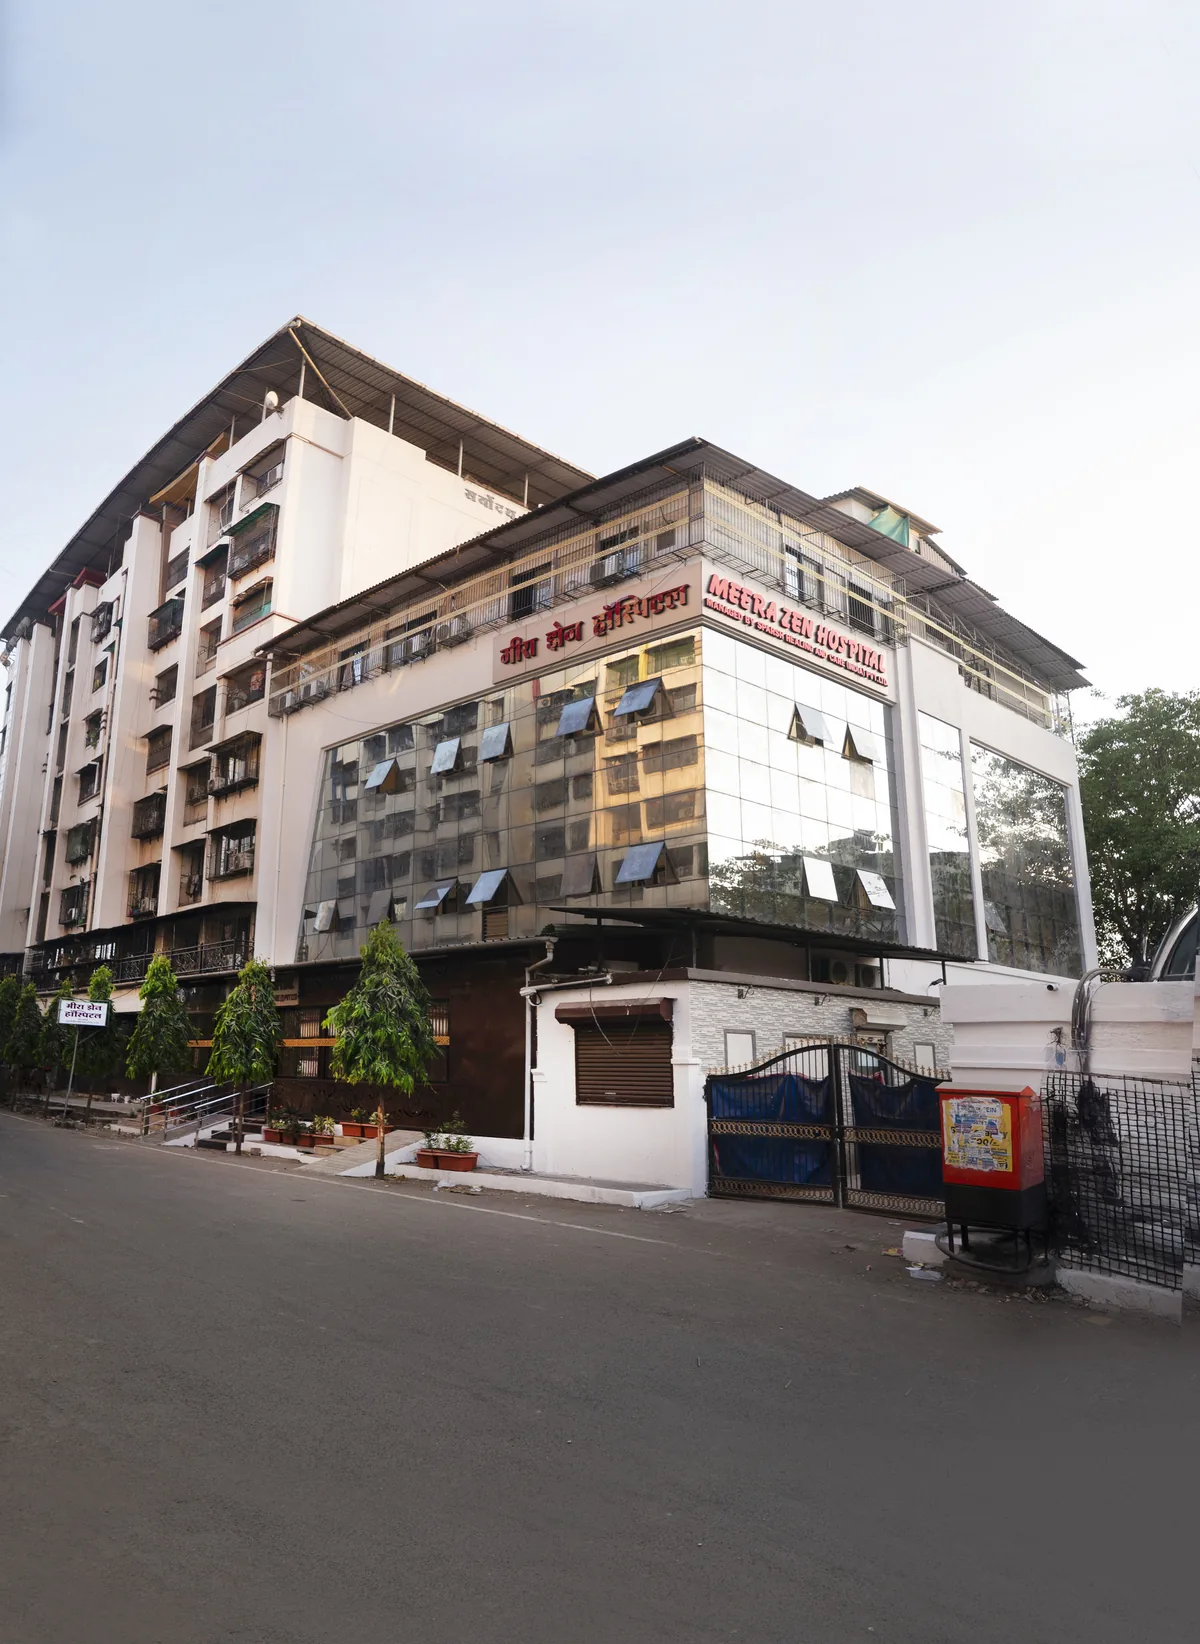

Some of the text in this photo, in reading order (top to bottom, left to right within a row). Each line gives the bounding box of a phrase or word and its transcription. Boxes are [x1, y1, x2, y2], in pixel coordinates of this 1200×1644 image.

[499, 583, 690, 665] मीरा झेन हॉस्पिटल
[704, 597, 743, 622] MANAGED
[743, 614, 755, 626] BY
[755, 620, 785, 642] SPARSH
[784, 634, 814, 654] HEALING
[813, 646, 828, 660] AND
[828, 654, 846, 669] CARE
[845, 660, 865, 678] (INDIA)
[707, 573, 886, 674] MEERA ZEN HOSPITAL
[64, 1010, 102, 1019] हॉस्पिटल
[66, 1001, 102, 1011] मीरा झेन
